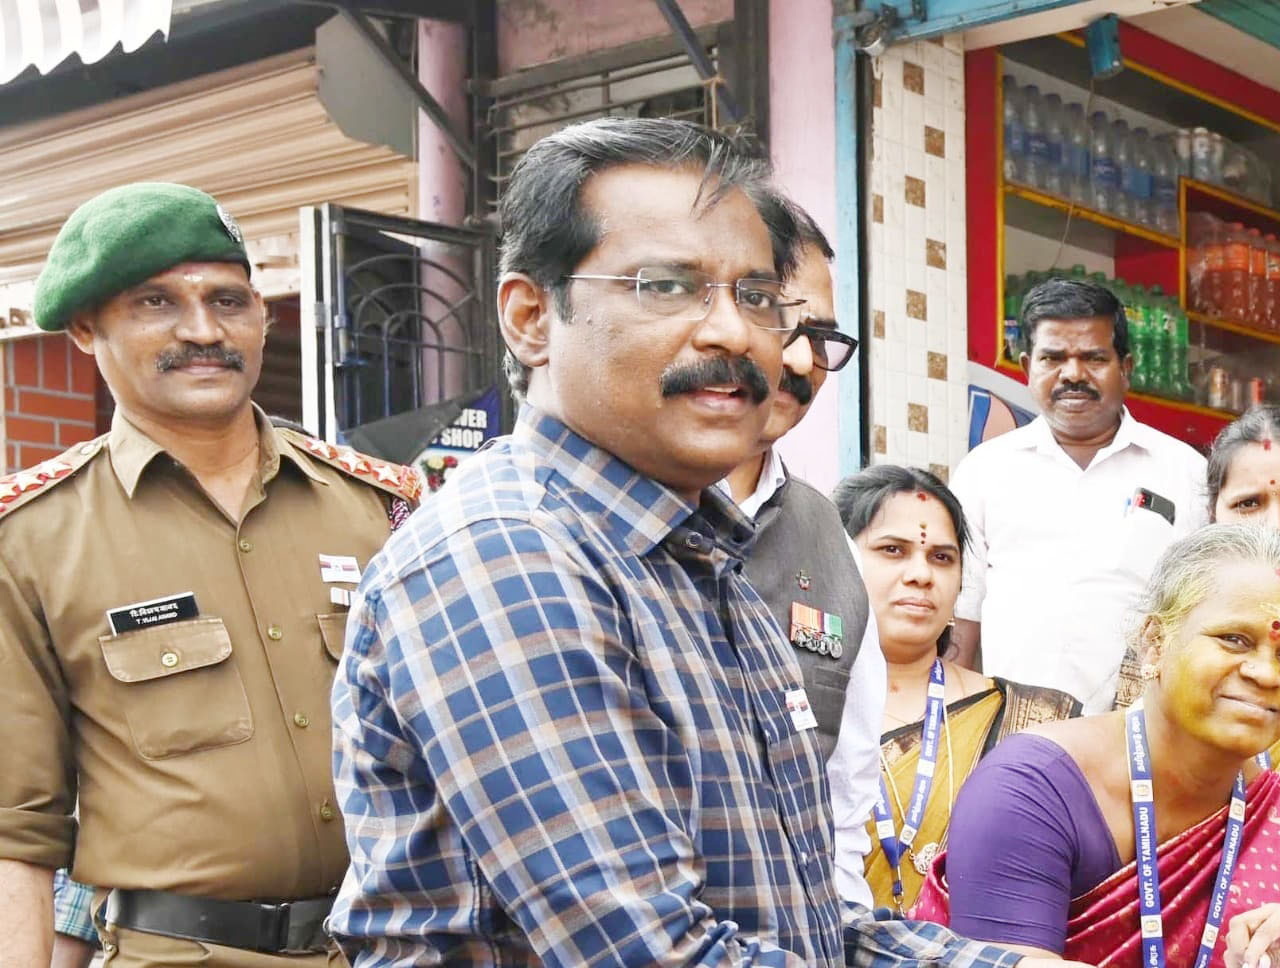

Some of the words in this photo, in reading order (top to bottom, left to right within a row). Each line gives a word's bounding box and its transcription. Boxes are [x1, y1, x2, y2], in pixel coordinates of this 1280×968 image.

[441, 427, 484, 449] SHOP
[1139, 806, 1150, 861] TAMILNADU
[1223, 824, 1240, 876] TAMILNADU
[1144, 864, 1152, 877] OF
[1219, 877, 1228, 890] OF
[1145, 879, 1155, 908] GOVT.
[1213, 891, 1225, 919] GOVT.
